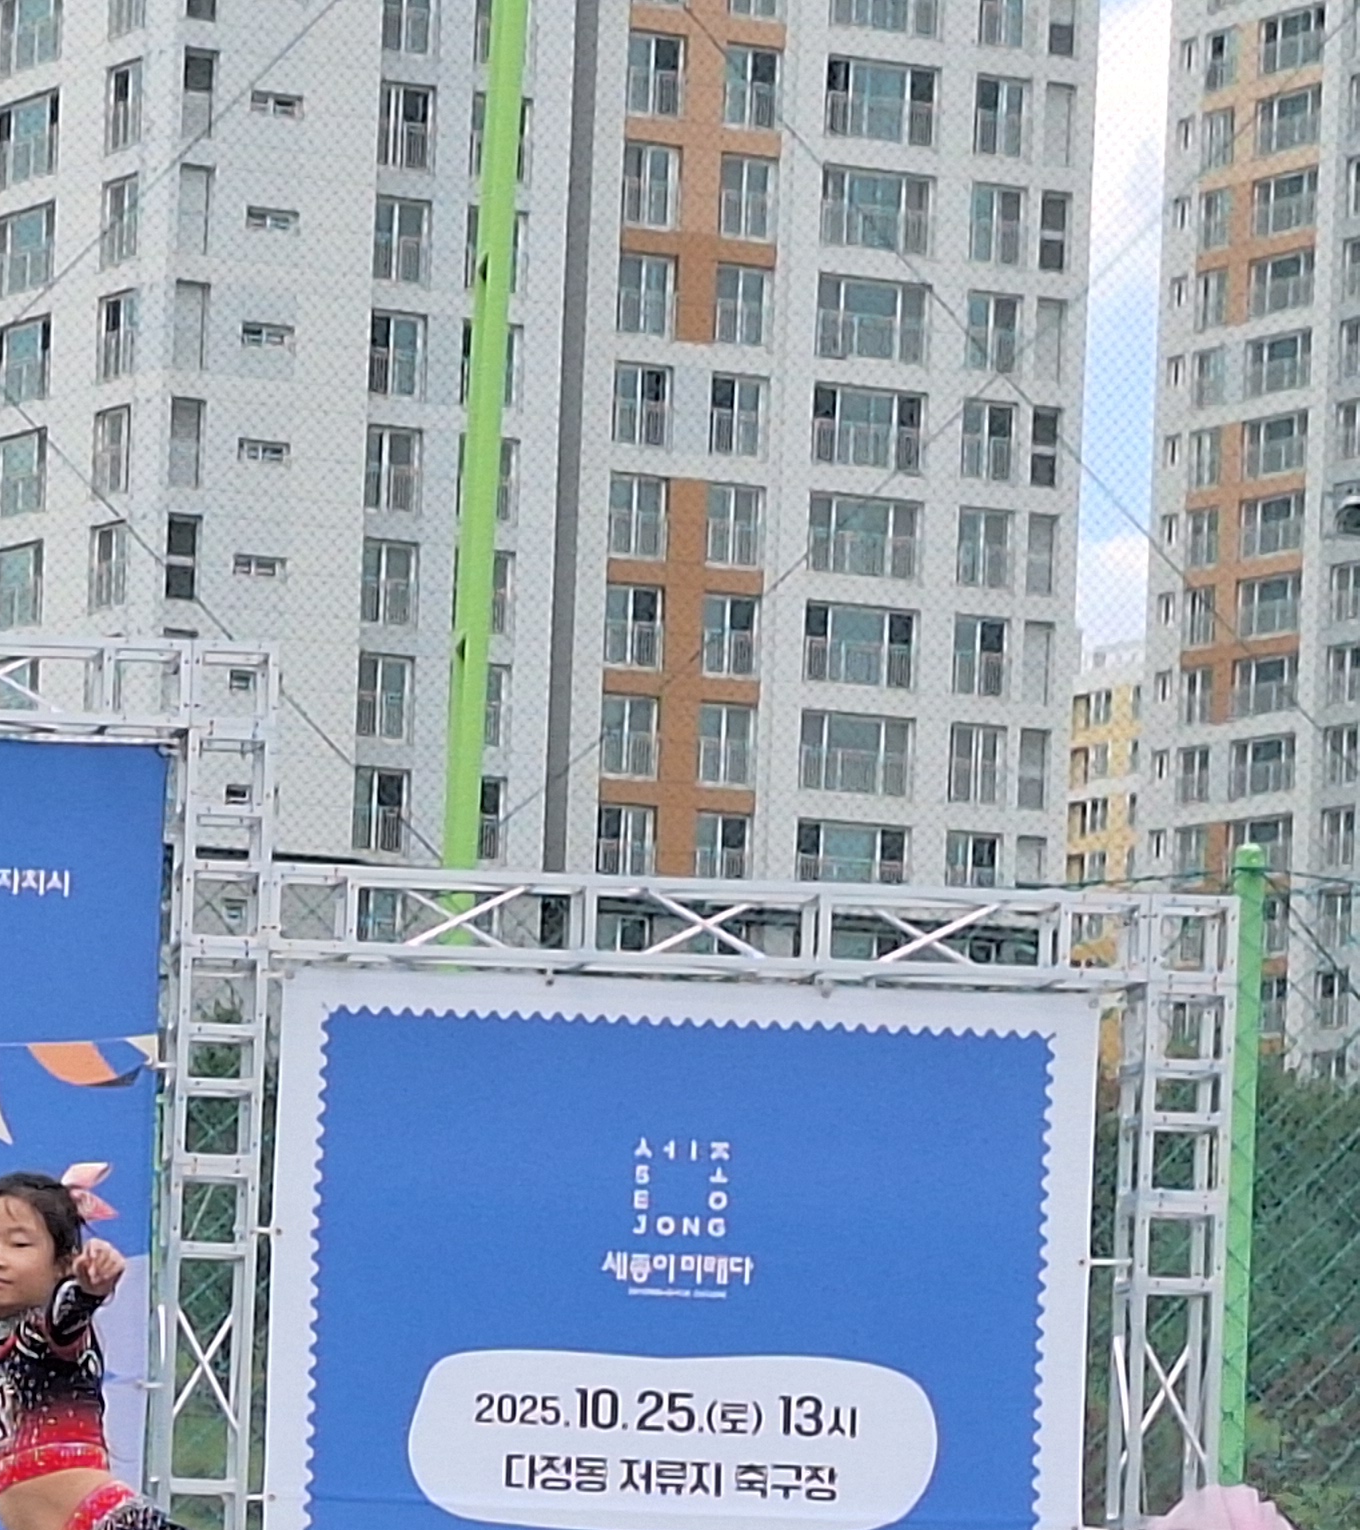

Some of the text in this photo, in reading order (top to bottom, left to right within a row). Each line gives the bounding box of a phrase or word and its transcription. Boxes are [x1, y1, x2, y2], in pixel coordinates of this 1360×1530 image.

[779, 1394, 859, 1439] 13시
[503, 1453, 839, 1502] 다정동 저류지 축구장
